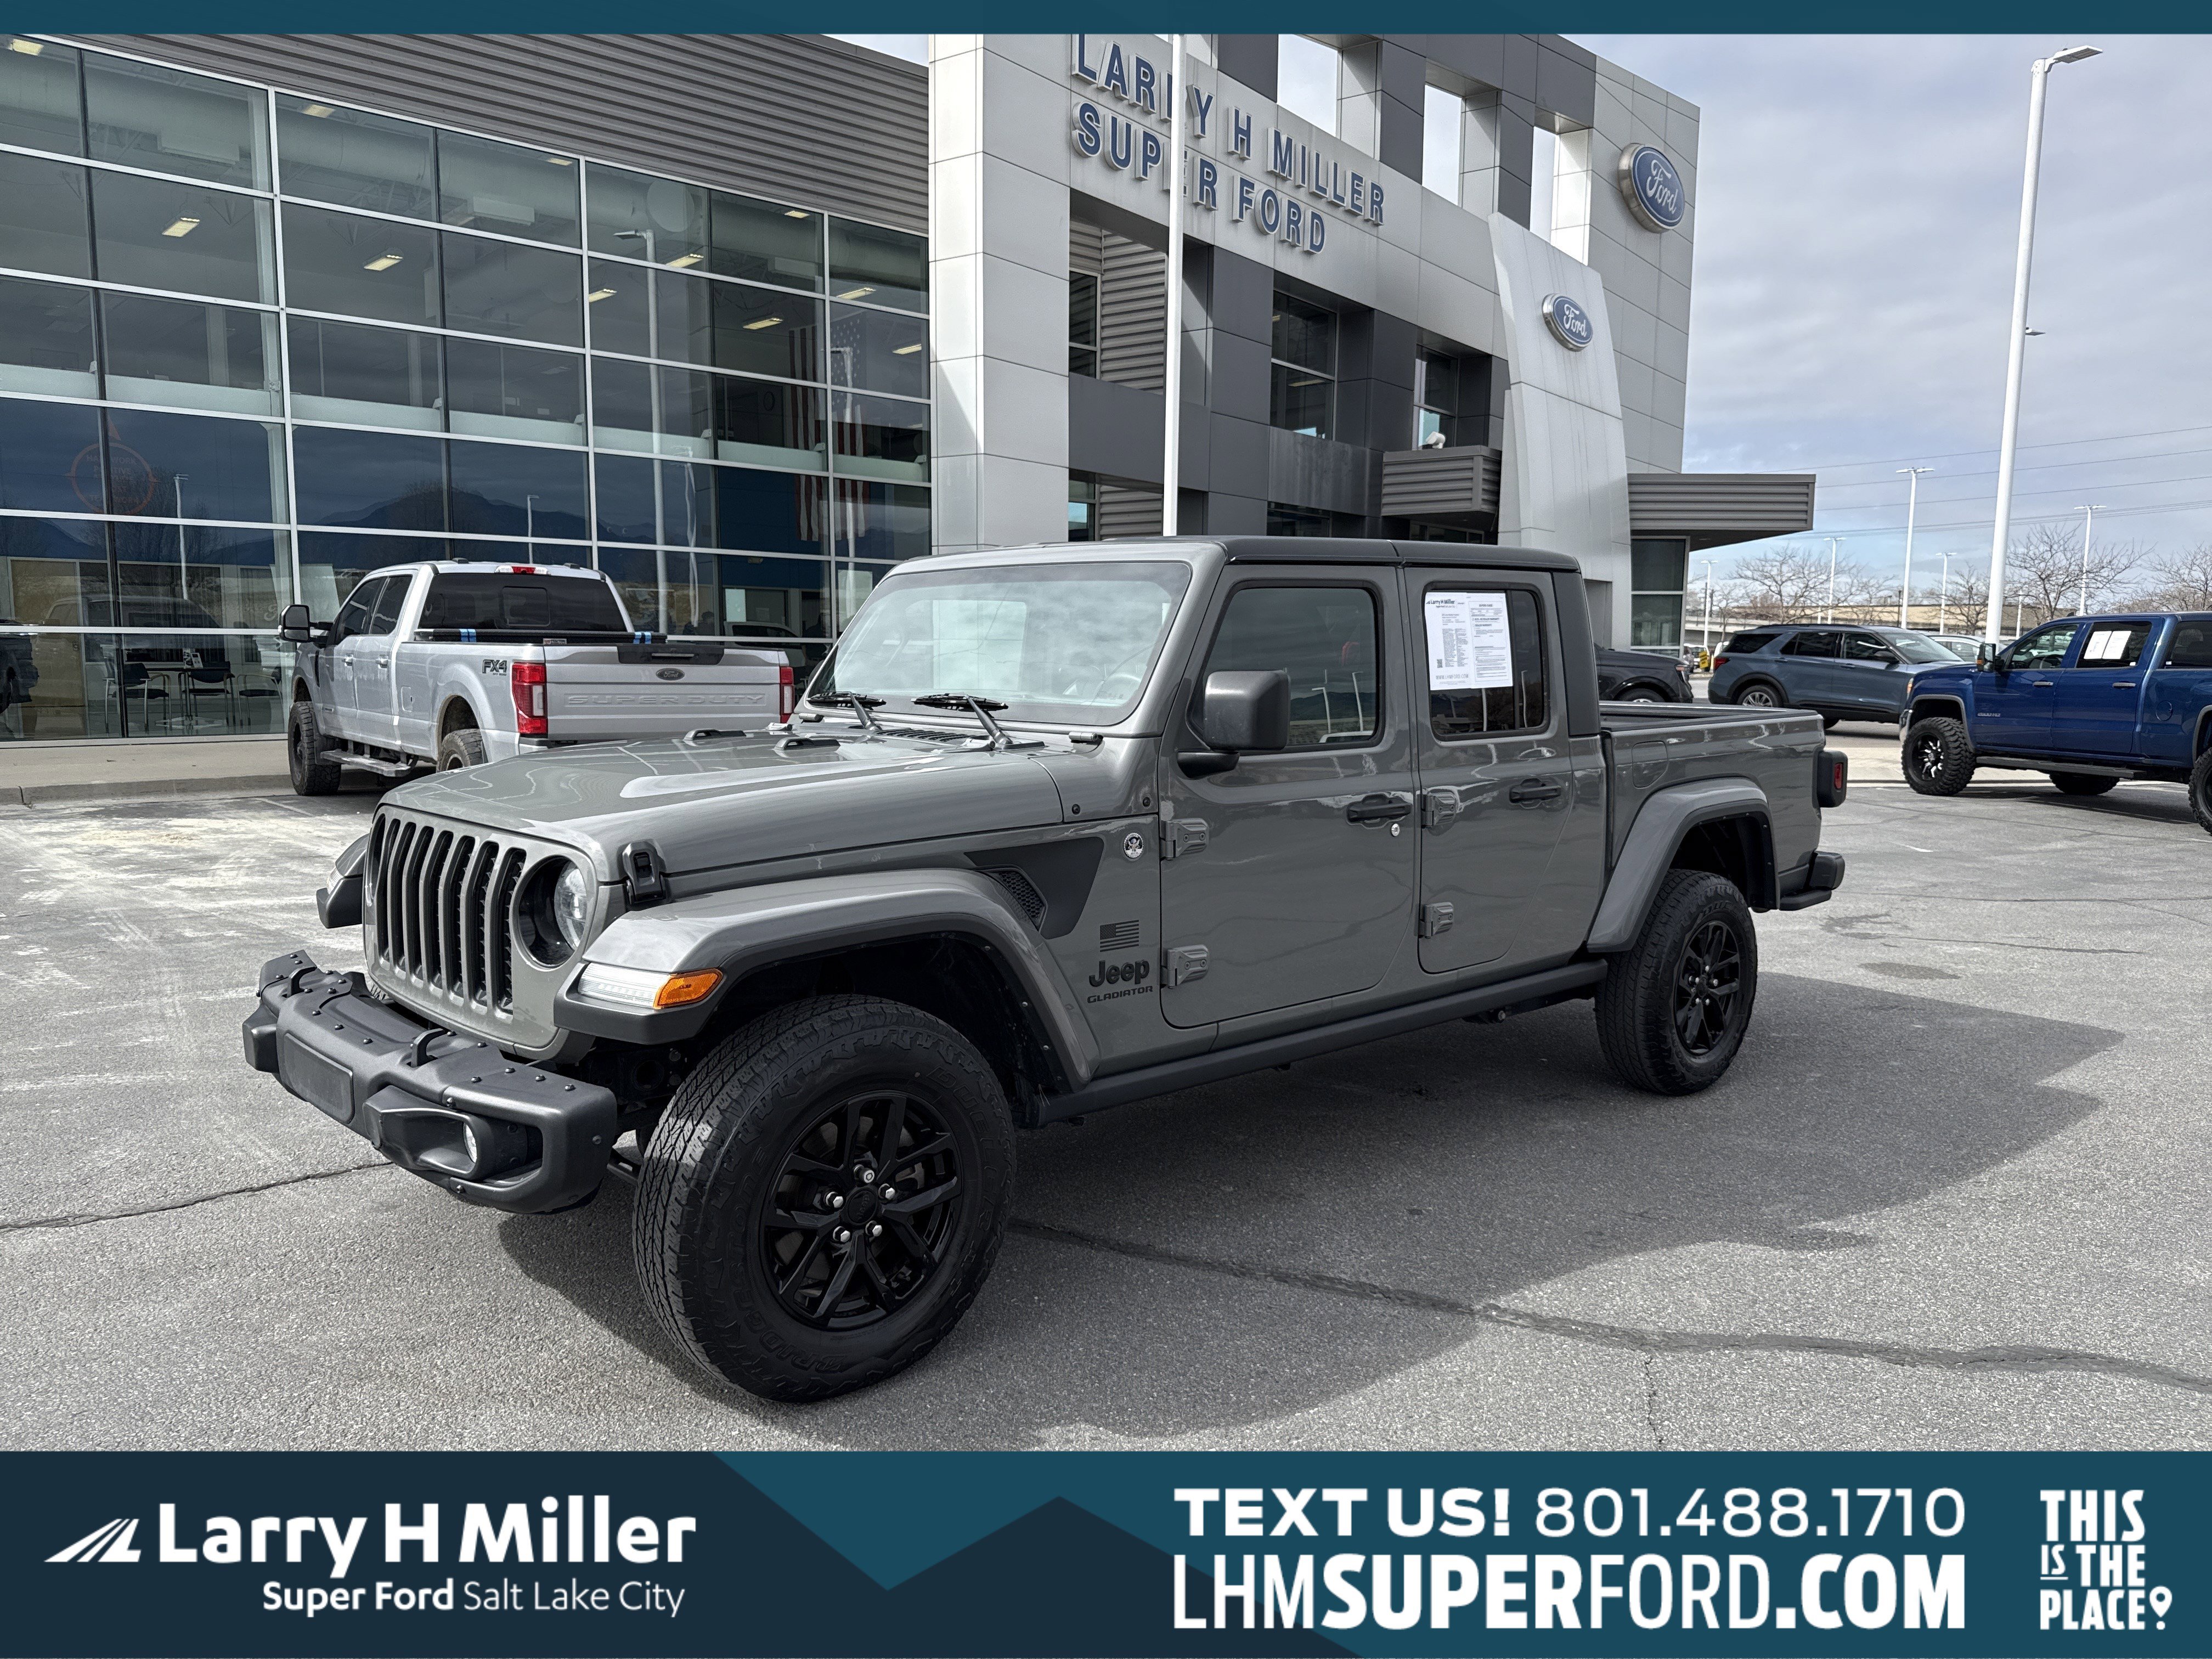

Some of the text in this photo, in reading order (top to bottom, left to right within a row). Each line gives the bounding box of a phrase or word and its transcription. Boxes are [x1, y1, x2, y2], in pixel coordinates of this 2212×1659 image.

[1073, 33, 1385, 225] LARY H MILLER
[1646, 159, 1677, 215] Ford
[1233, 174, 1325, 254] FORD
[1563, 303, 1587, 337] Ford
[482, 659, 507, 674] FX4
[568, 695, 764, 704] SUPER DUTY
[1089, 960, 1150, 987] Jeep
[1087, 985, 1153, 1003] GLADIATOR
[727, 1146, 844, 1373] BRIDGESTONE
